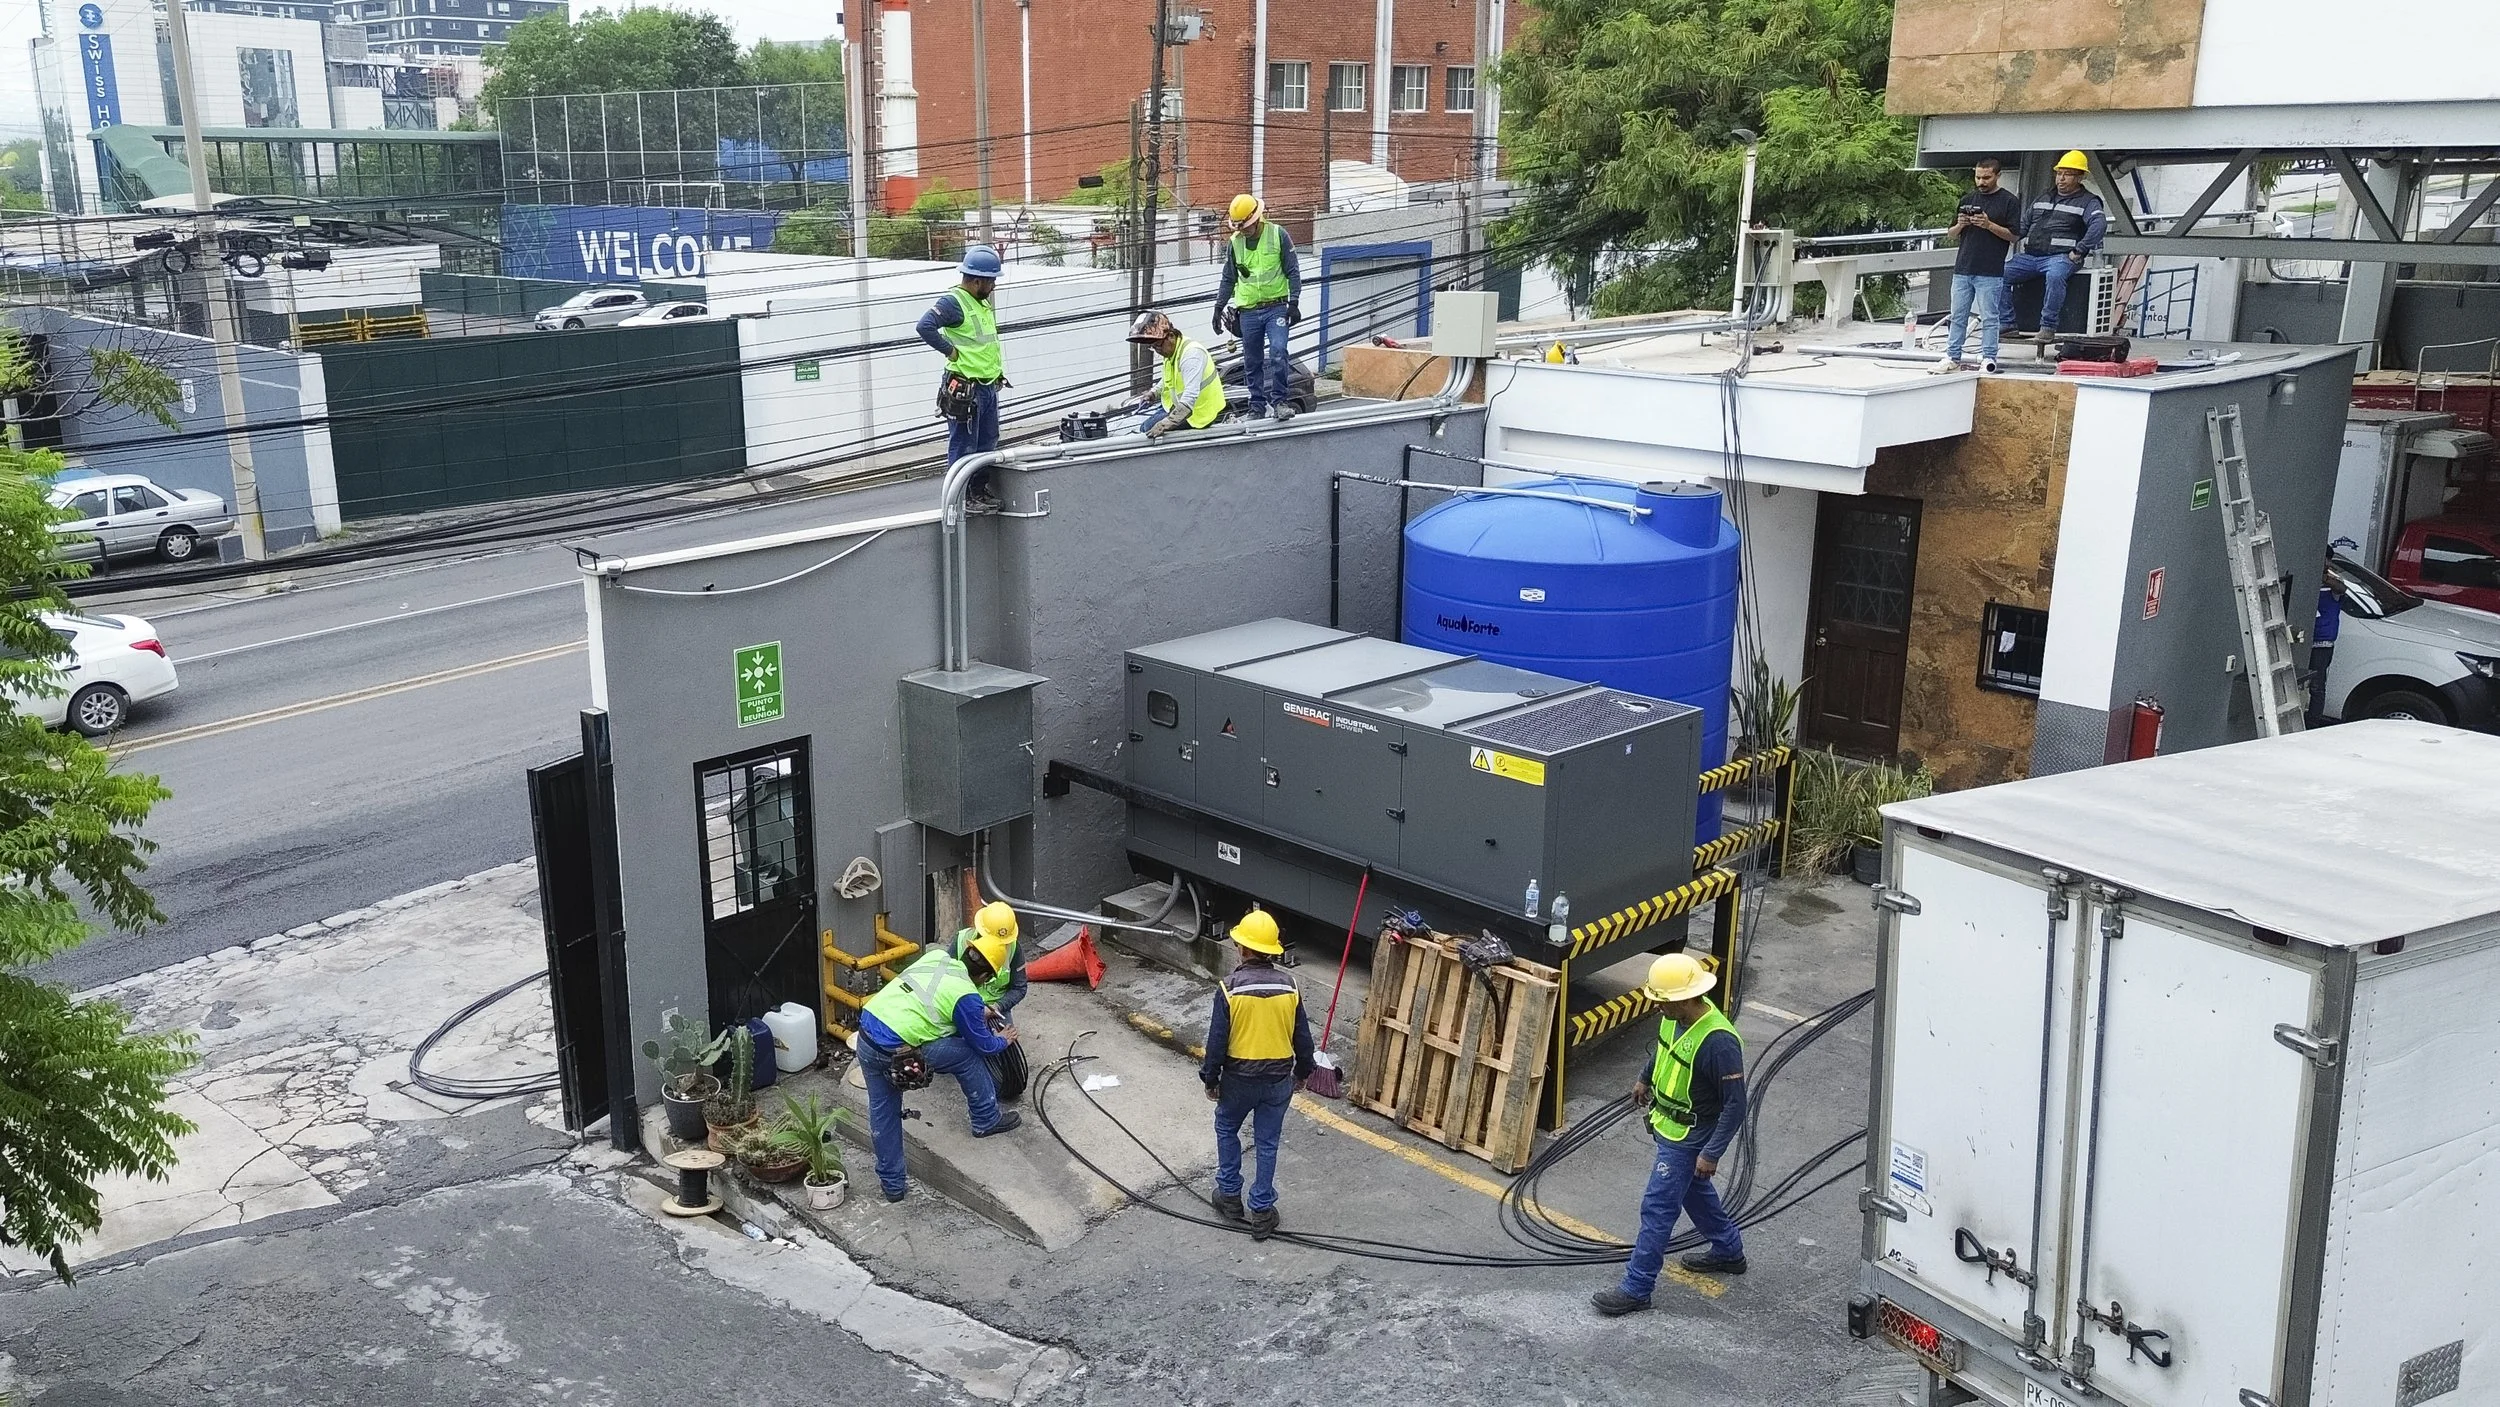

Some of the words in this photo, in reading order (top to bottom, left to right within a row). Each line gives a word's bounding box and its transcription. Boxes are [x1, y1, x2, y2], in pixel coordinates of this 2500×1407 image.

[747, 697, 773, 708] PUNTO
[756, 705, 766, 713] DE
[1283, 702, 1331, 721] GENERAC
[1336, 716, 1379, 732] INDUSTRIAL
[1336, 723, 1363, 734] POWER
